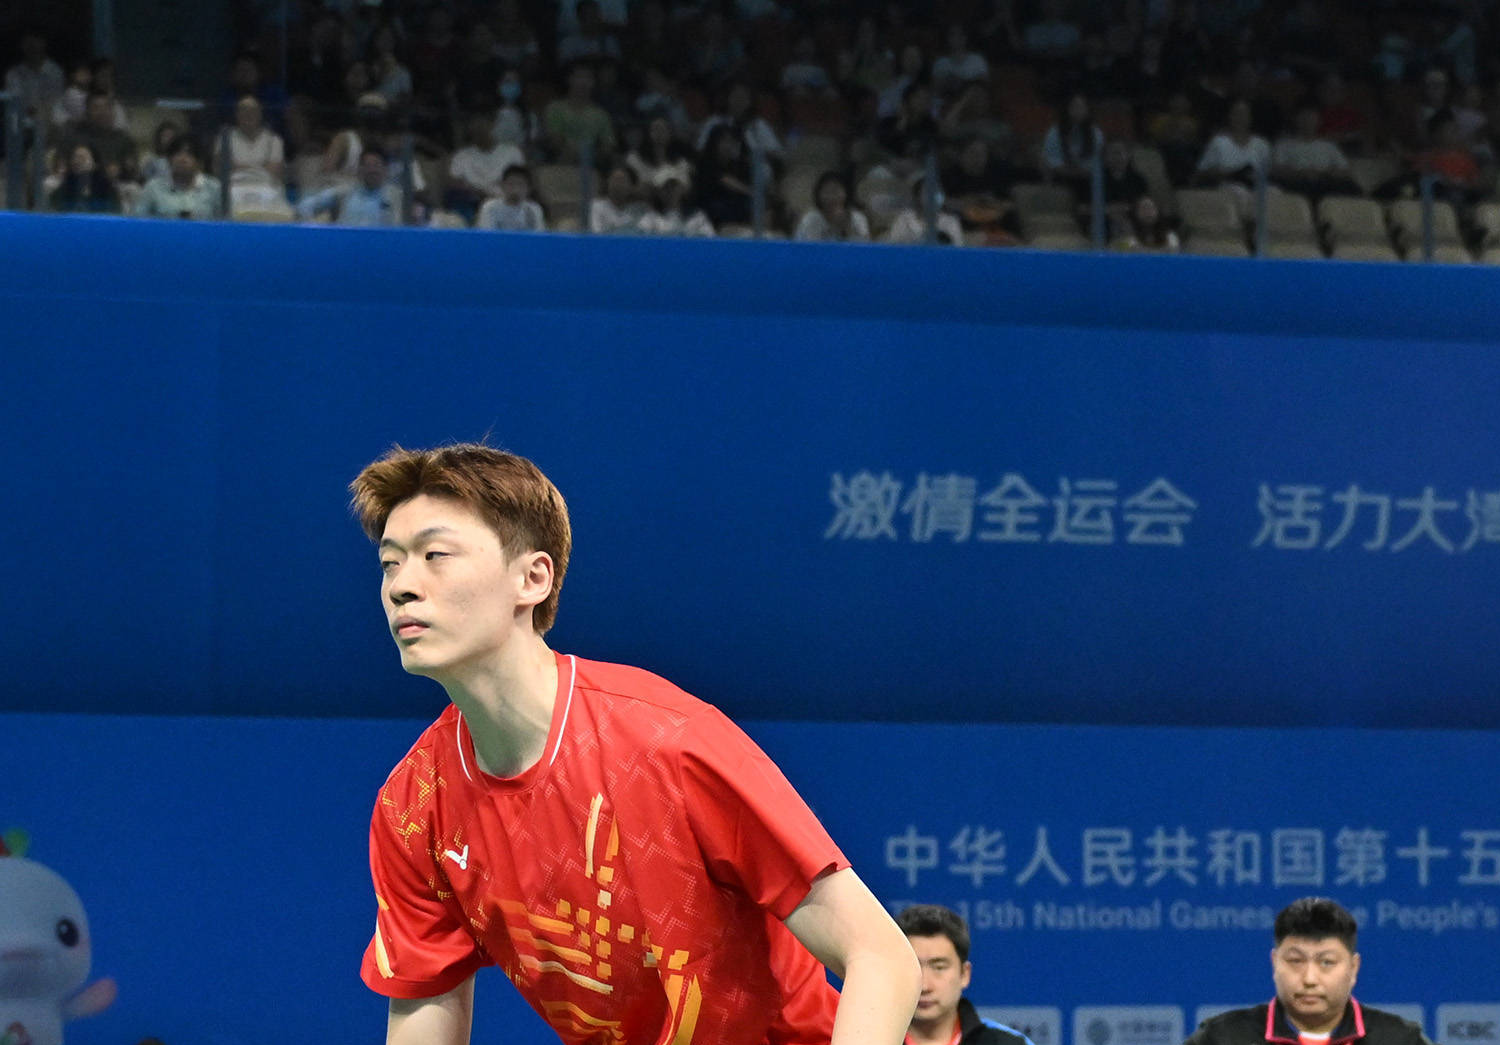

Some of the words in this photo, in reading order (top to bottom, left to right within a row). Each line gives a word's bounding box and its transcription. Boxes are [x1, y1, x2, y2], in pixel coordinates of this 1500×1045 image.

[823, 470, 1199, 548] 激情全运会
[1033, 901, 1163, 930] National
[1169, 900, 1275, 930] Games
[1376, 900, 1499, 934] People's
